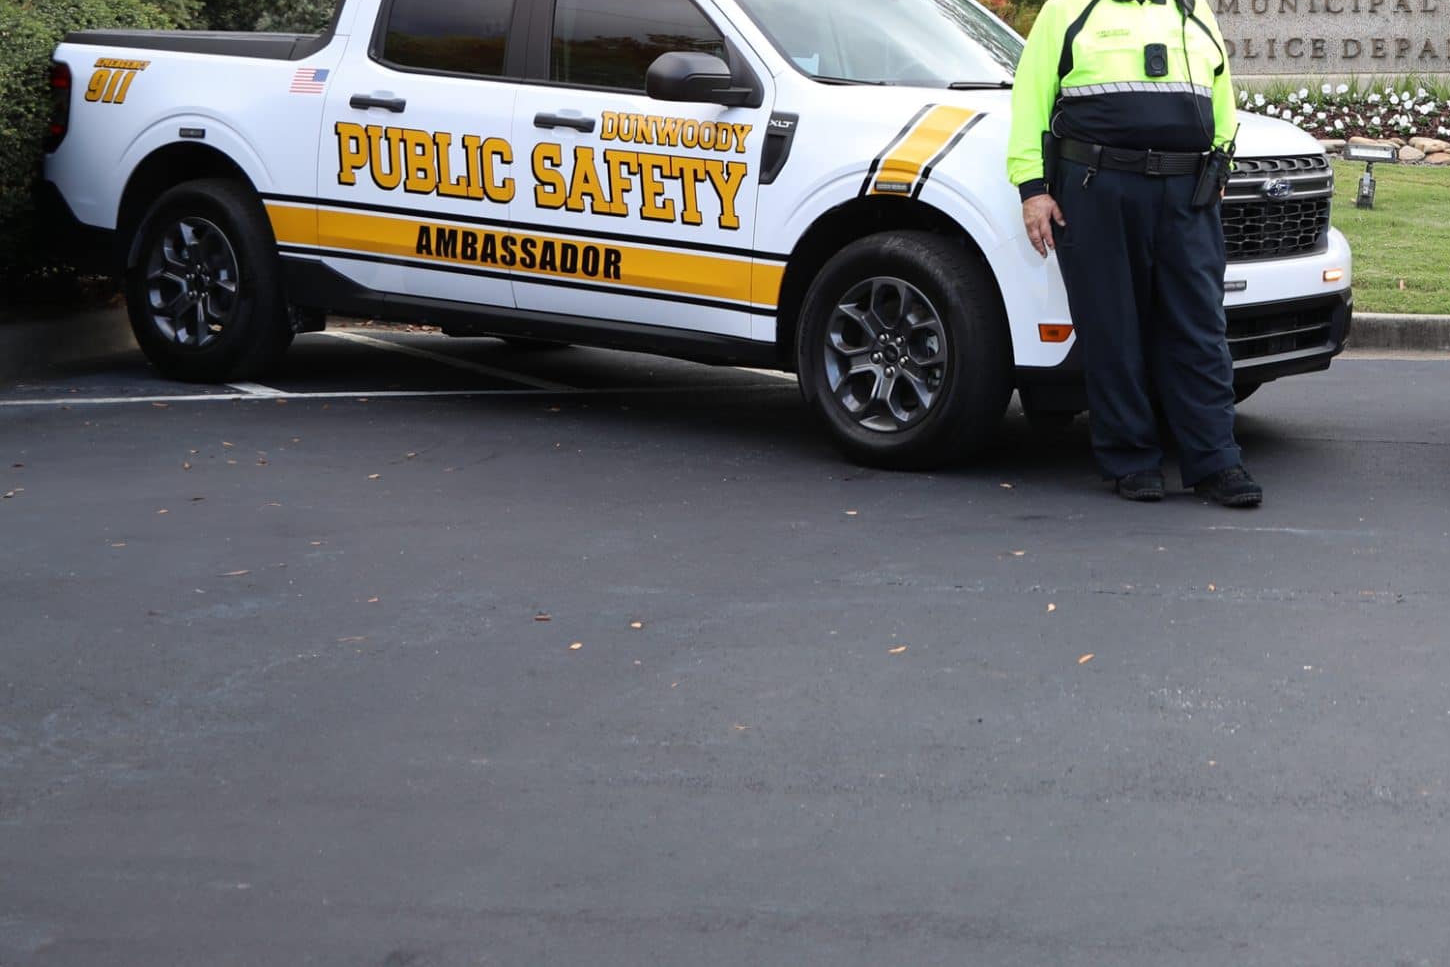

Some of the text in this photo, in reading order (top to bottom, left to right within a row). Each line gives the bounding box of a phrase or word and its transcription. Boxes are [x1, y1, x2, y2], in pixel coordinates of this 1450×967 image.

[1223, 37, 1327, 60] LICE
[85, 69, 137, 105] 911
[601, 110, 753, 154] DUNWOODY
[770, 119, 794, 128] XLT
[335, 121, 749, 231] PUBLIC SAFETY
[415, 224, 622, 280] AMBASSADOR
